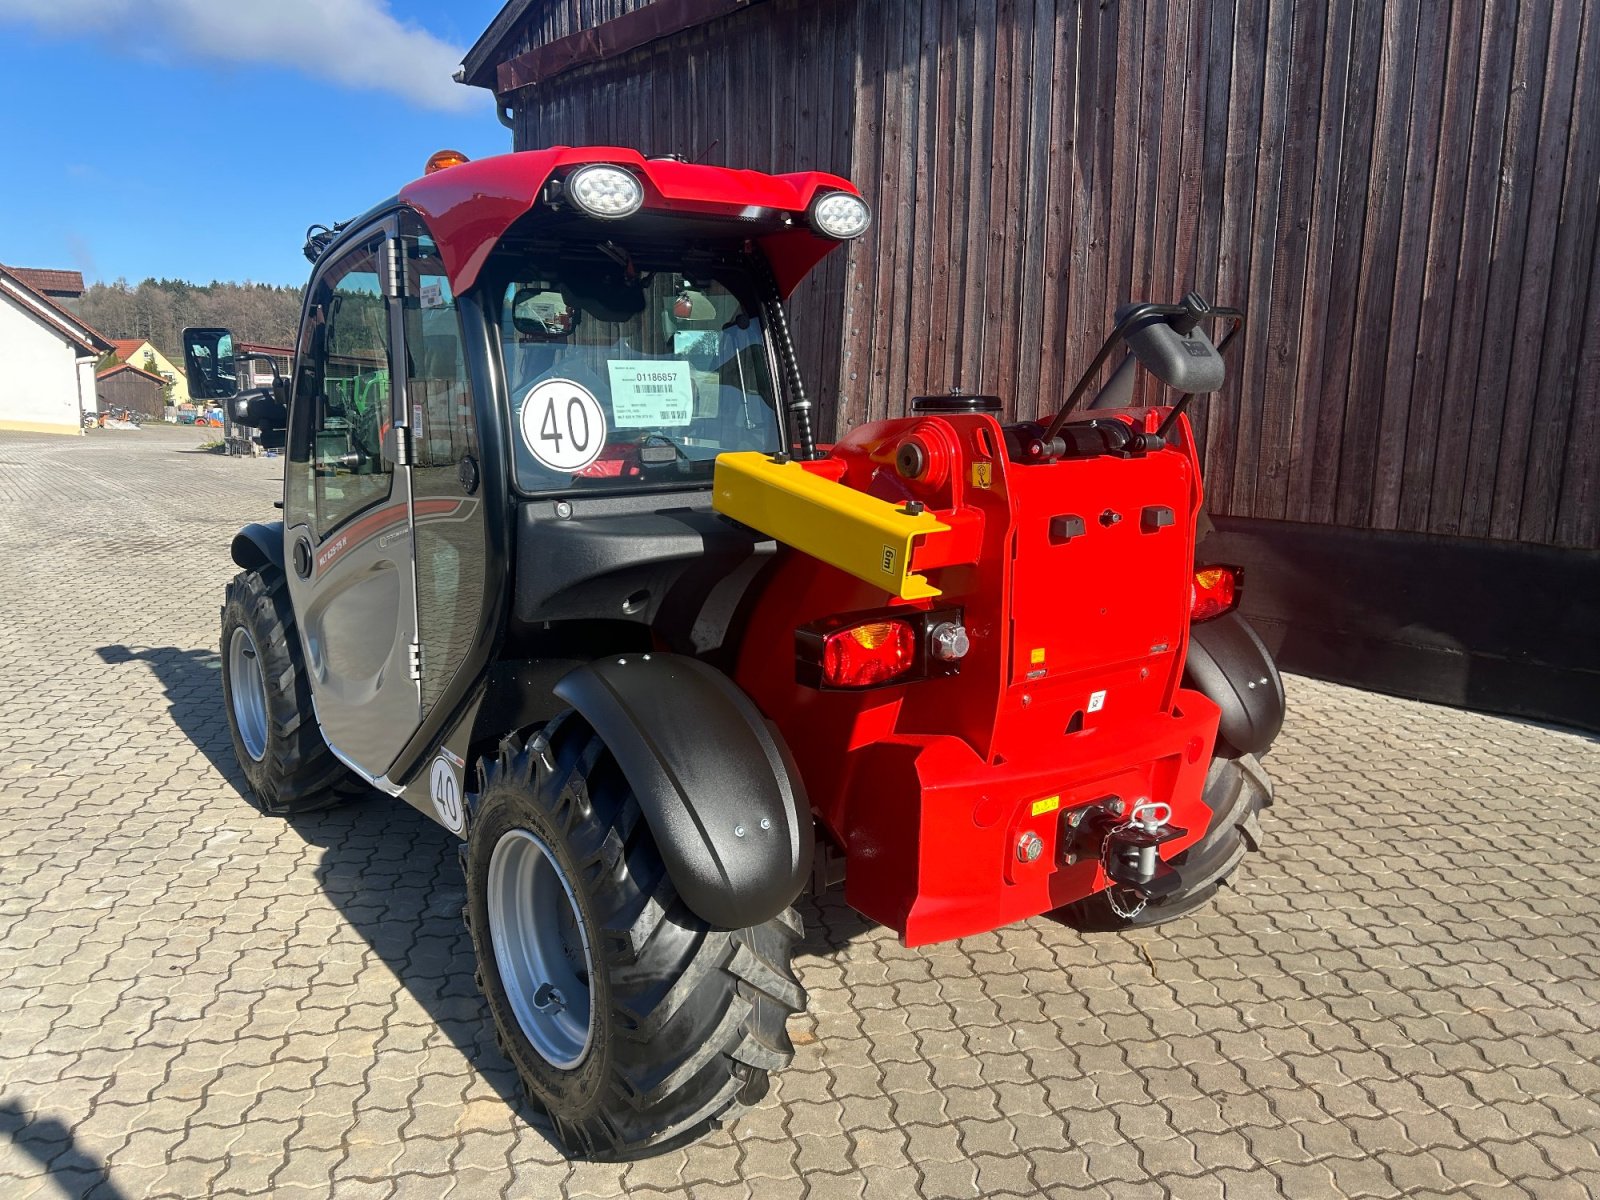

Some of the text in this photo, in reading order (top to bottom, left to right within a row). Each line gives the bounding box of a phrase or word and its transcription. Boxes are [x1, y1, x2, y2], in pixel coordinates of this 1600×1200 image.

[636, 372, 677, 382] 01186857
[540, 396, 589, 454] 40
[883, 550, 894, 569] 6m
[436, 770, 457, 822] 40
